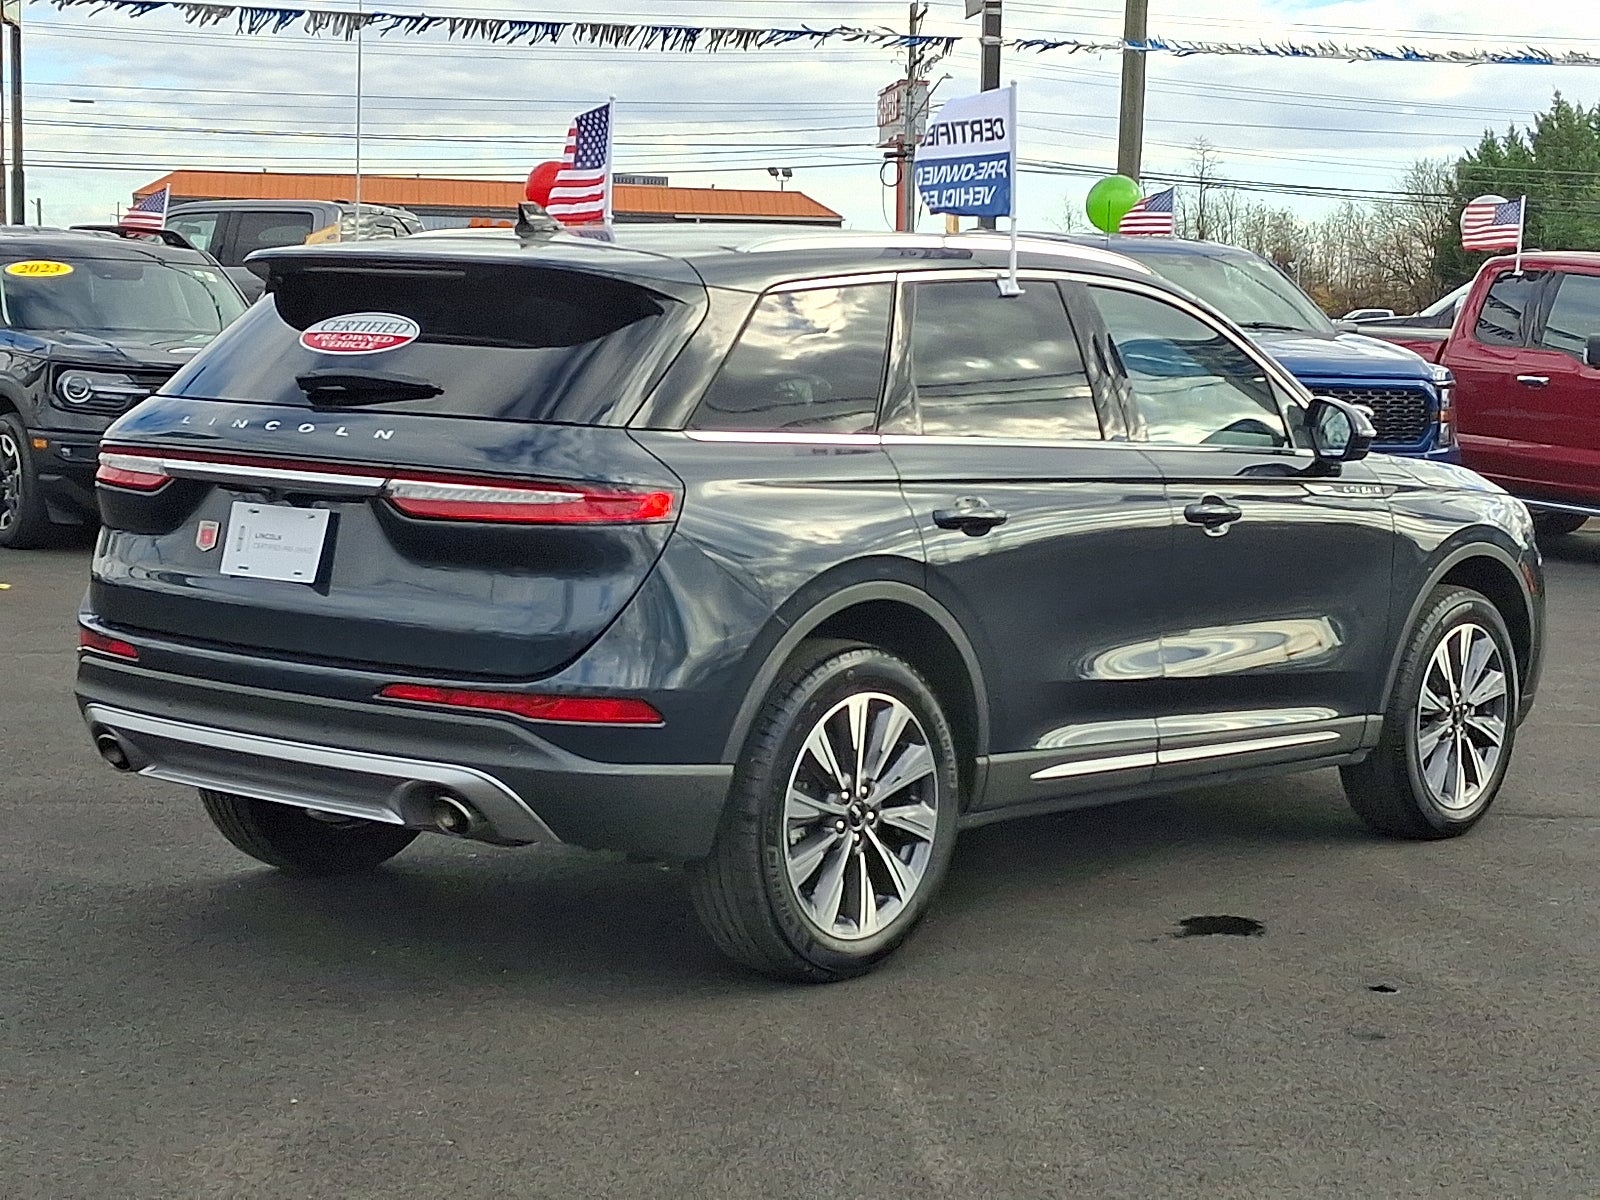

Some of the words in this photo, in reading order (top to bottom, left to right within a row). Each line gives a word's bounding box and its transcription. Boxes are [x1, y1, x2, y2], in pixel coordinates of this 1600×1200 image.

[17, 263, 61, 274] 2023
[320, 319, 411, 334] CERTIFIED
[314, 333, 395, 344] PRE-OWNED
[320, 340, 379, 350] VEHICLE
[181, 415, 395, 440] LINCOLN
